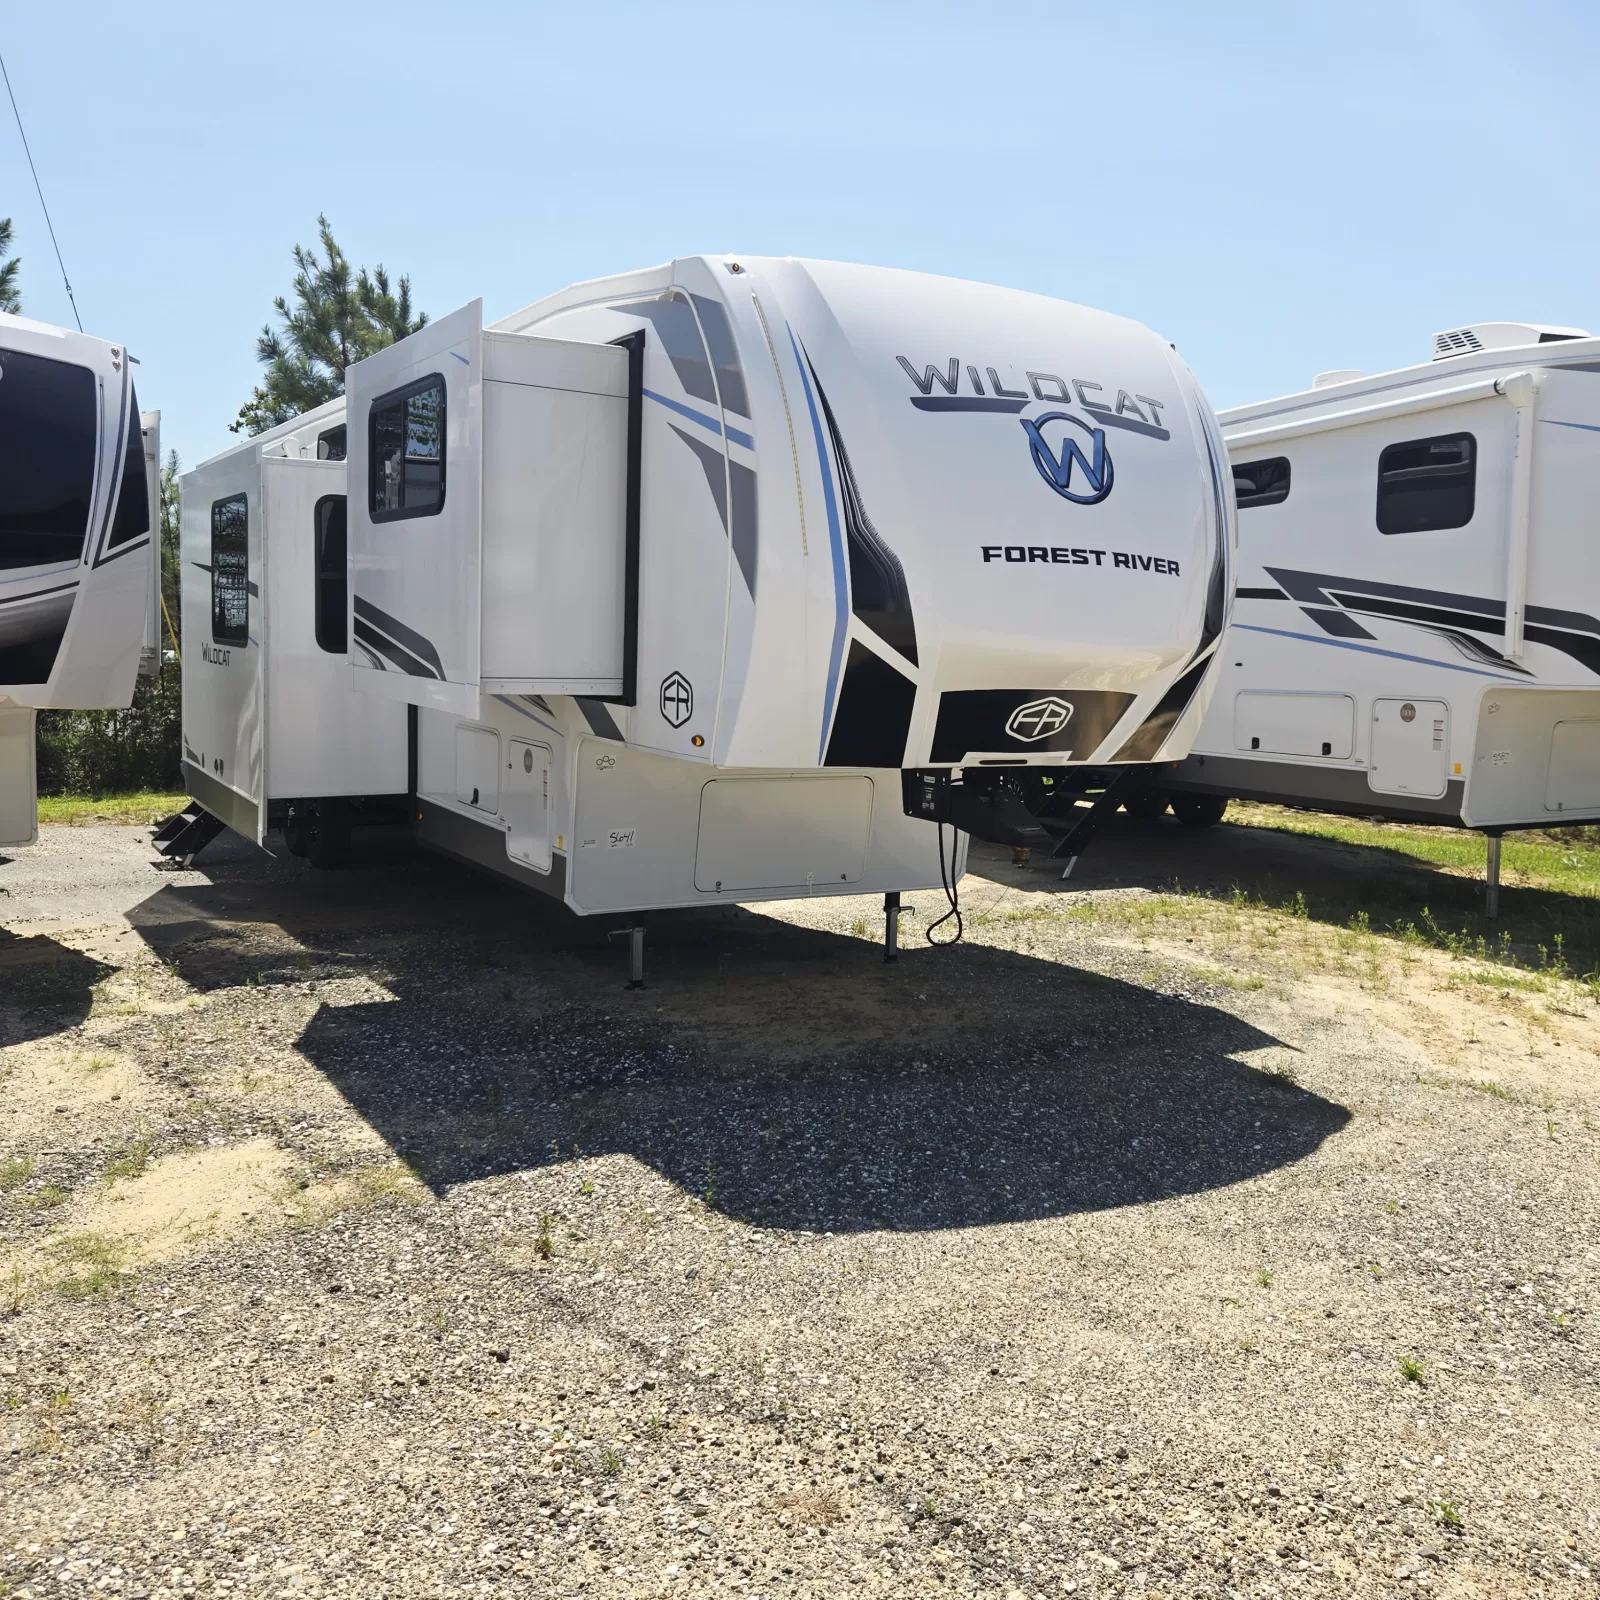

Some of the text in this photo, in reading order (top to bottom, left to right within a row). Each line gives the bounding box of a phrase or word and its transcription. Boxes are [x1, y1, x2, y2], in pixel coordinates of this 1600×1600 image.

[896, 356, 1163, 426] WILDCAT
[980, 546, 1180, 577] FOREST RIVER
[201, 642, 231, 666] WILDCAT
